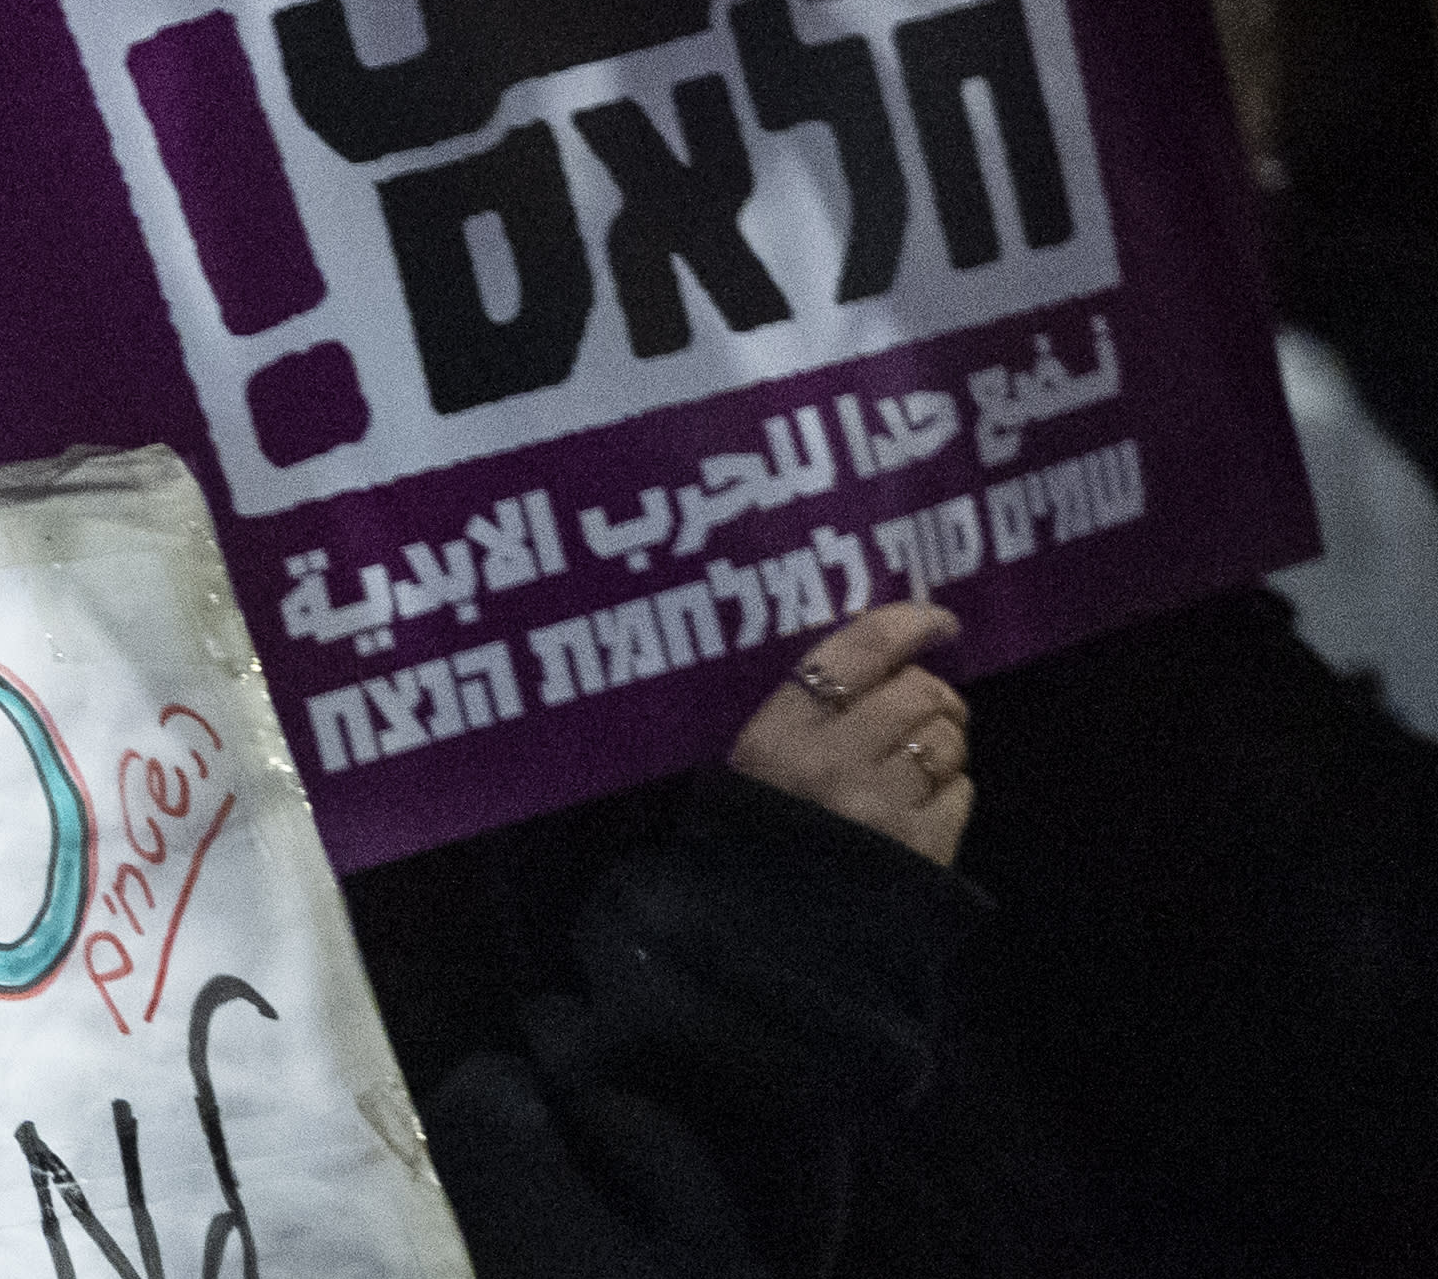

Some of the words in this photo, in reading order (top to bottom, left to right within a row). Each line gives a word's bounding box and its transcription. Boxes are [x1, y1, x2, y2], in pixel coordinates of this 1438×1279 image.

[578, 403, 838, 572] للحرب
[871, 491, 984, 605] סוף
[986, 437, 1147, 565] שמים
[526, 523, 873, 707] למלחמת
[303, 638, 527, 774] הנצח
[85, 703, 225, 1035] השטחים
